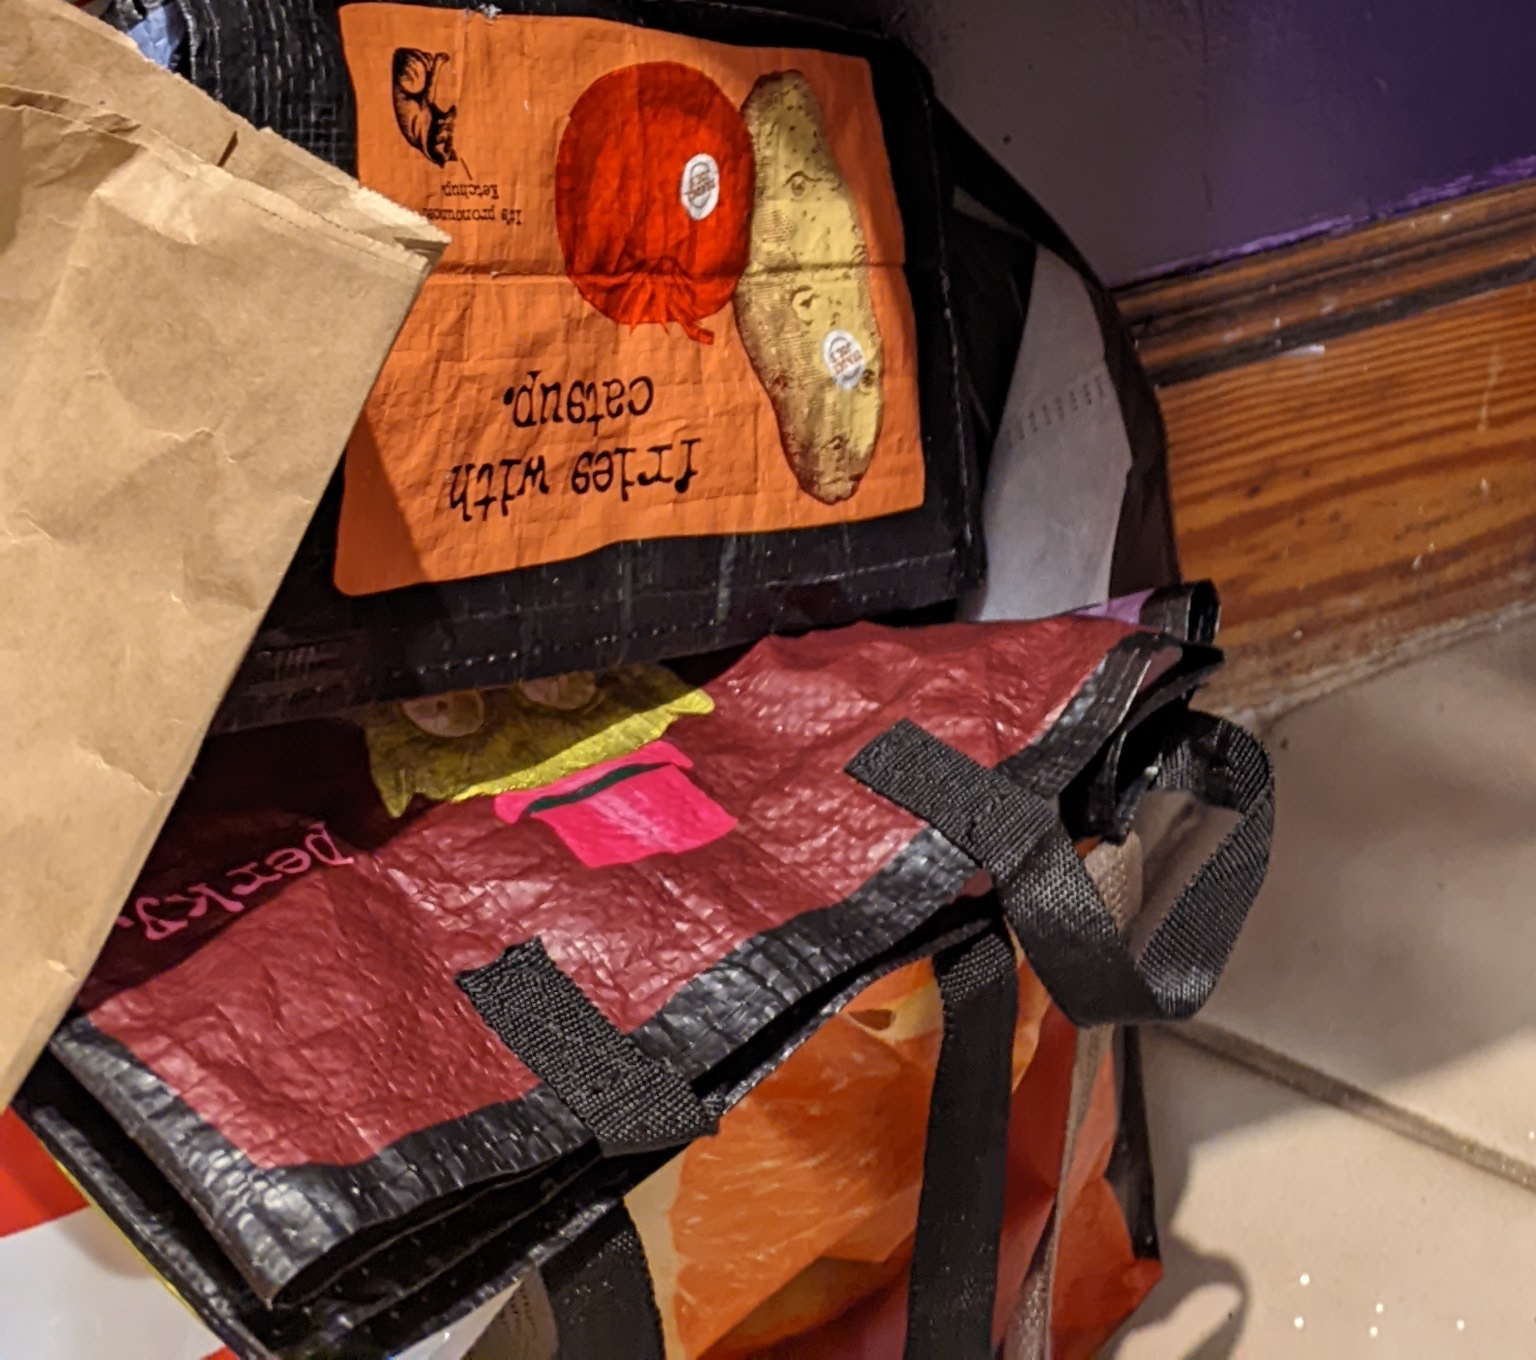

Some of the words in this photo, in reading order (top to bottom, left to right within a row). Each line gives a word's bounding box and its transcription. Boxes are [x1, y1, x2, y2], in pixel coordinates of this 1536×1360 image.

[502, 369, 656, 437] catsup.
[449, 453, 551, 522] with
[571, 436, 702, 503] fries
